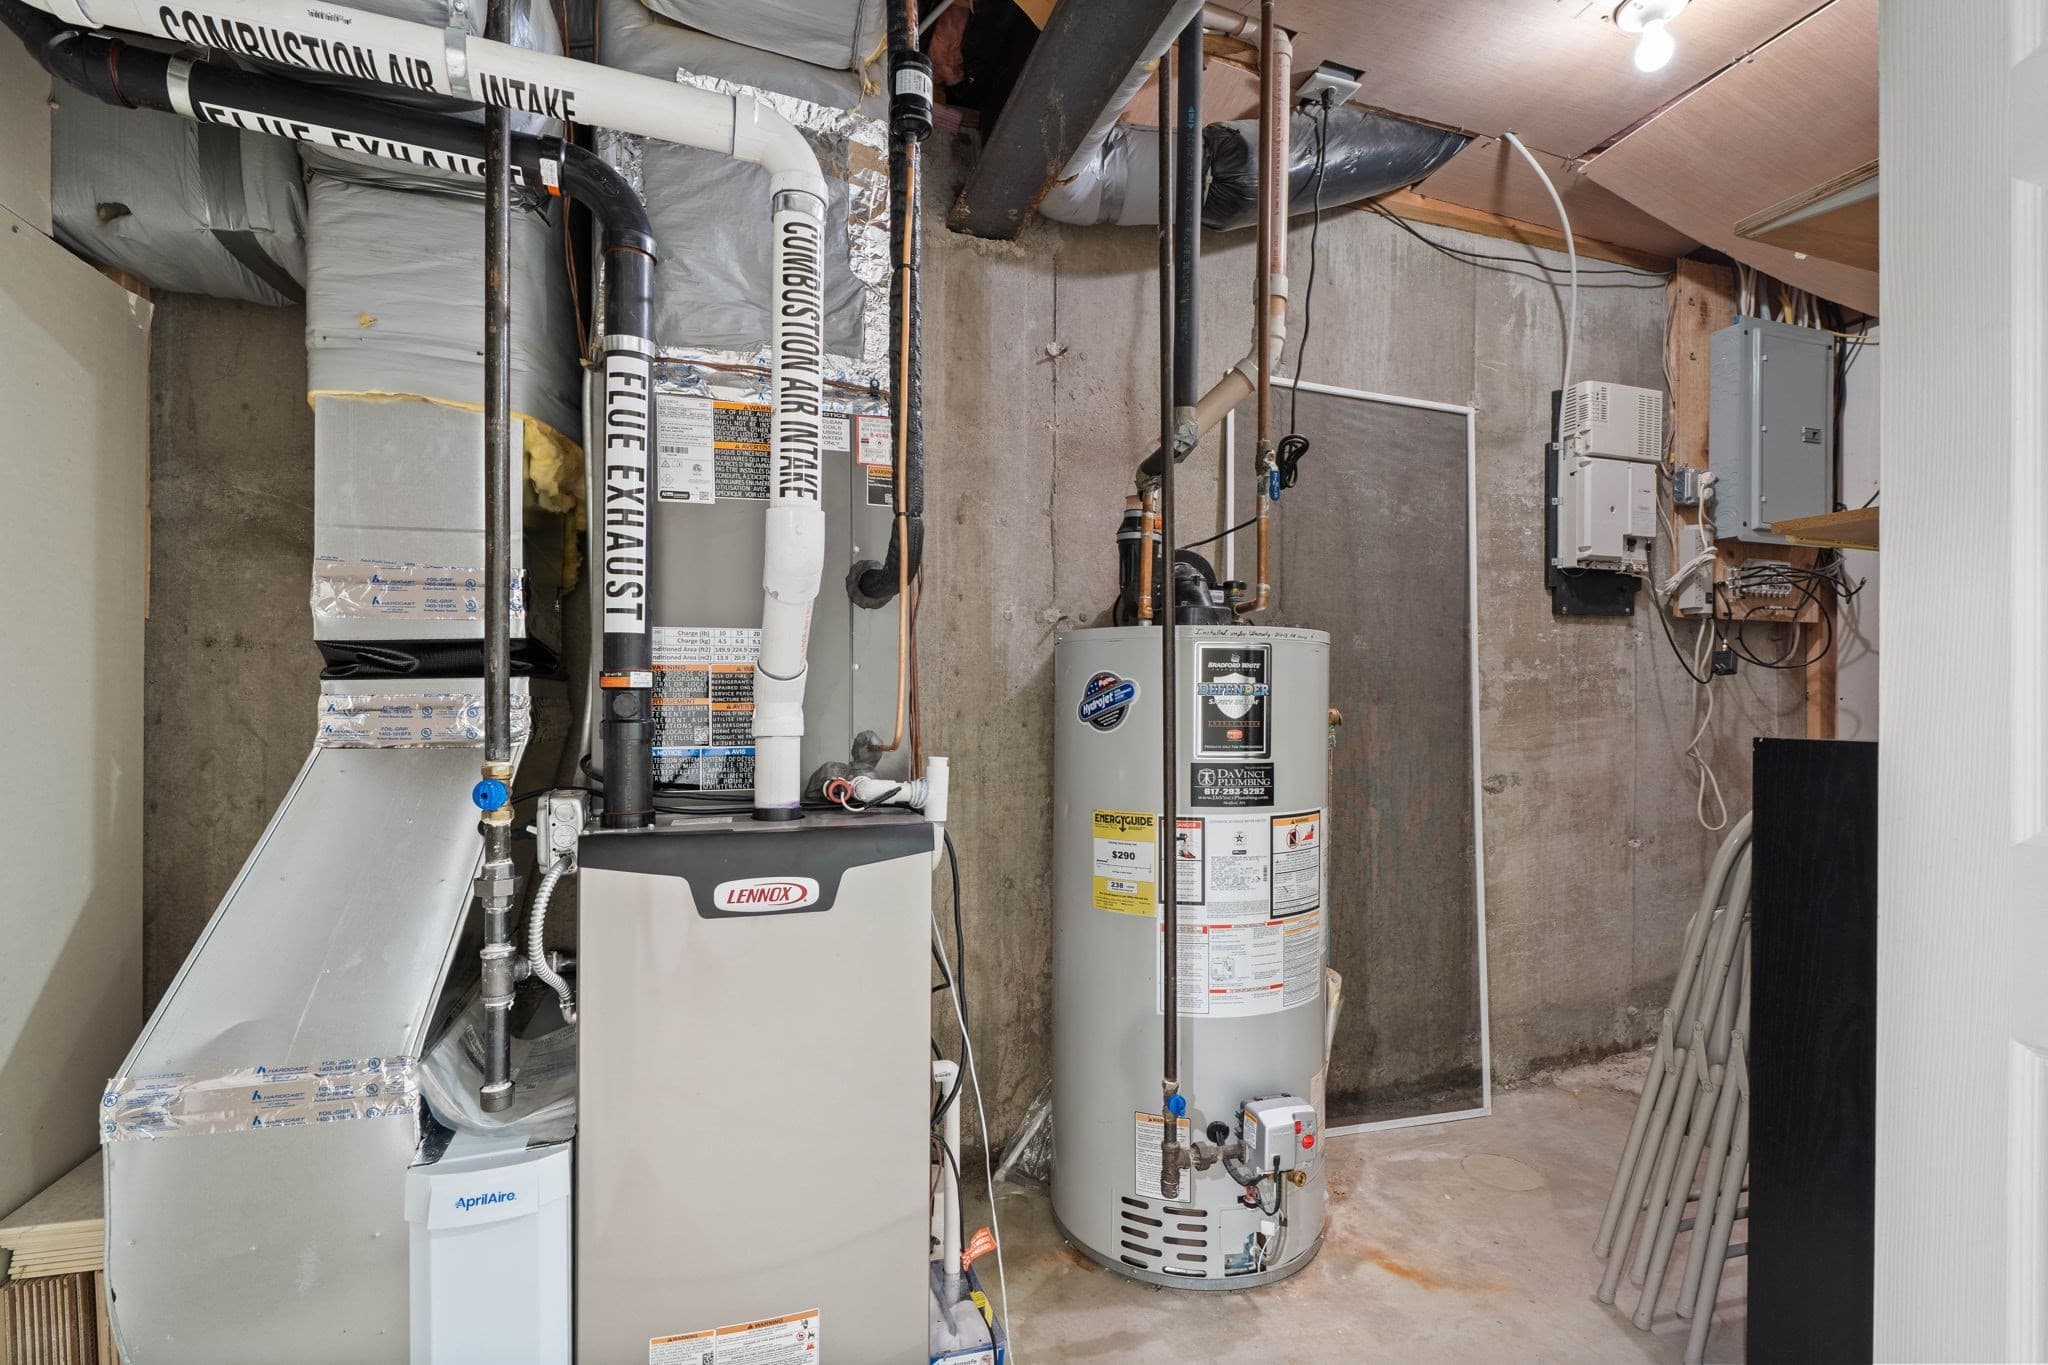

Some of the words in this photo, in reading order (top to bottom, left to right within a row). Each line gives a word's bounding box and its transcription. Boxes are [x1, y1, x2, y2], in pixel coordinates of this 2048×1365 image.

[159, 5, 377, 81] COMBUSTION
[386, 53, 434, 93] AIR
[480, 72, 576, 121] INTAKE
[781, 221, 820, 375] COMBUSTION
[607, 372, 646, 451] FLUE
[780, 376, 820, 416] AIR
[779, 420, 818, 500] INTAKE
[605, 464, 644, 621] EXHAUST
[1083, 692, 1113, 716] Hydrojet
[1198, 683, 1269, 696] DEFENDER
[1094, 813, 1153, 826] ENERGYGUIDE
[1112, 850, 1135, 860] $290
[726, 886, 792, 904] LENNOX
[456, 1190, 516, 1211] AprilAire
